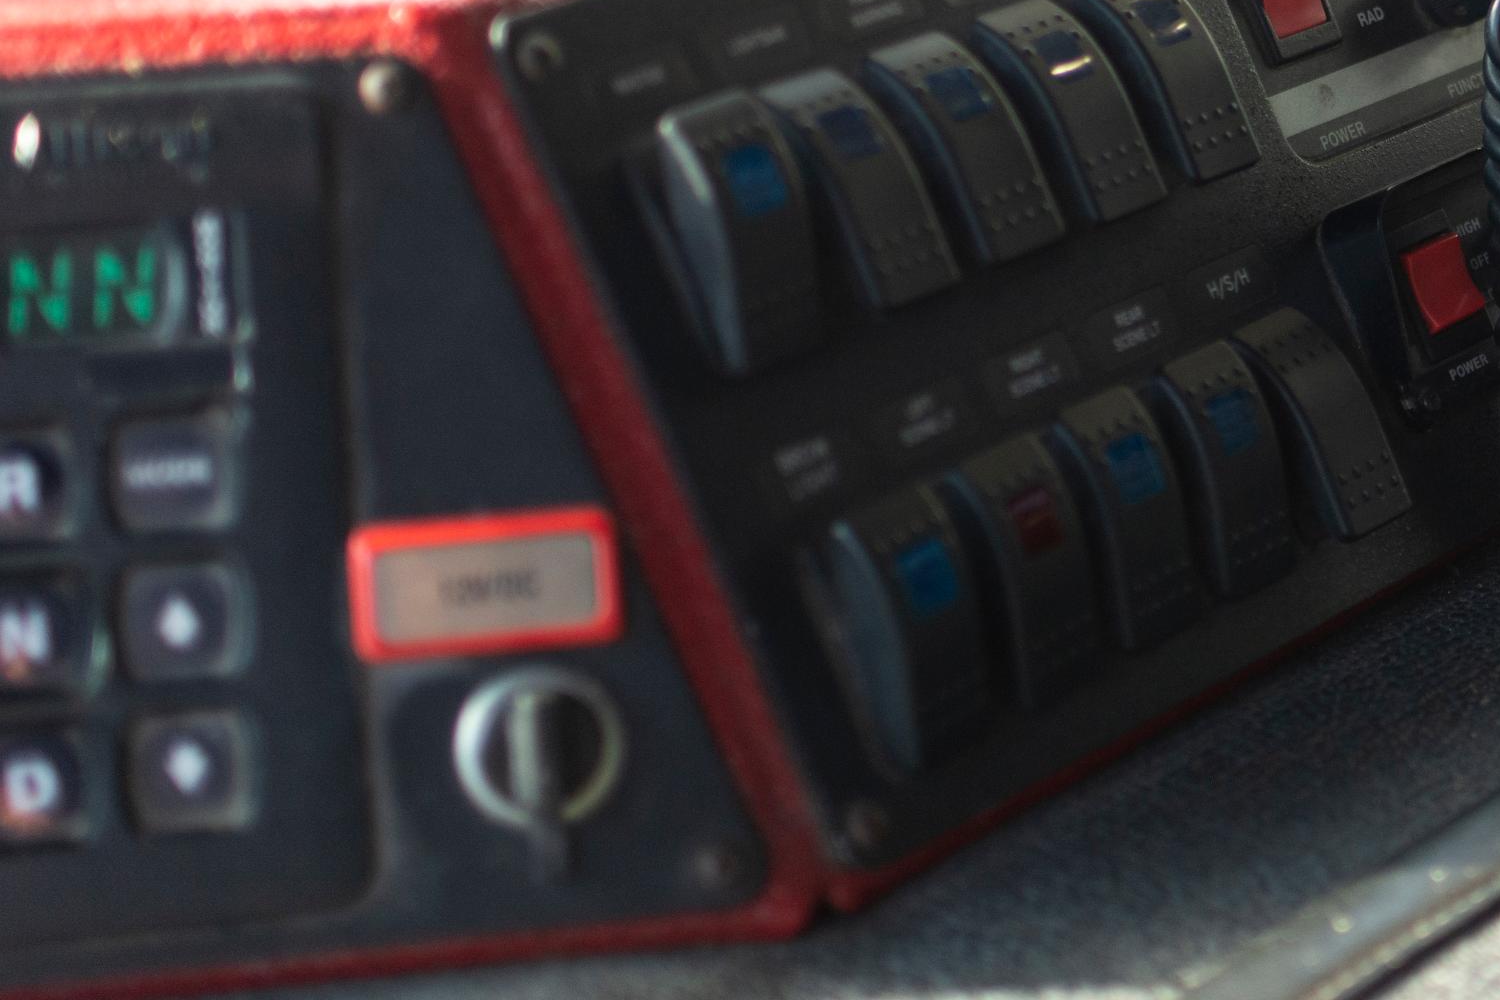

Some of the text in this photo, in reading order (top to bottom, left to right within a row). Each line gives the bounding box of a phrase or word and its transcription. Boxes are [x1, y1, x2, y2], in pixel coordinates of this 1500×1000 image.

[1356, 6, 1385, 28] RAD
[1446, 71, 1485, 99] FUNCT
[1319, 120, 1368, 152] POWER
[1469, 250, 1490, 271] OFF
[1206, 266, 1252, 301] H/S/H
[1447, 353, 1489, 382] POWER
[4, 757, 60, 816] D
